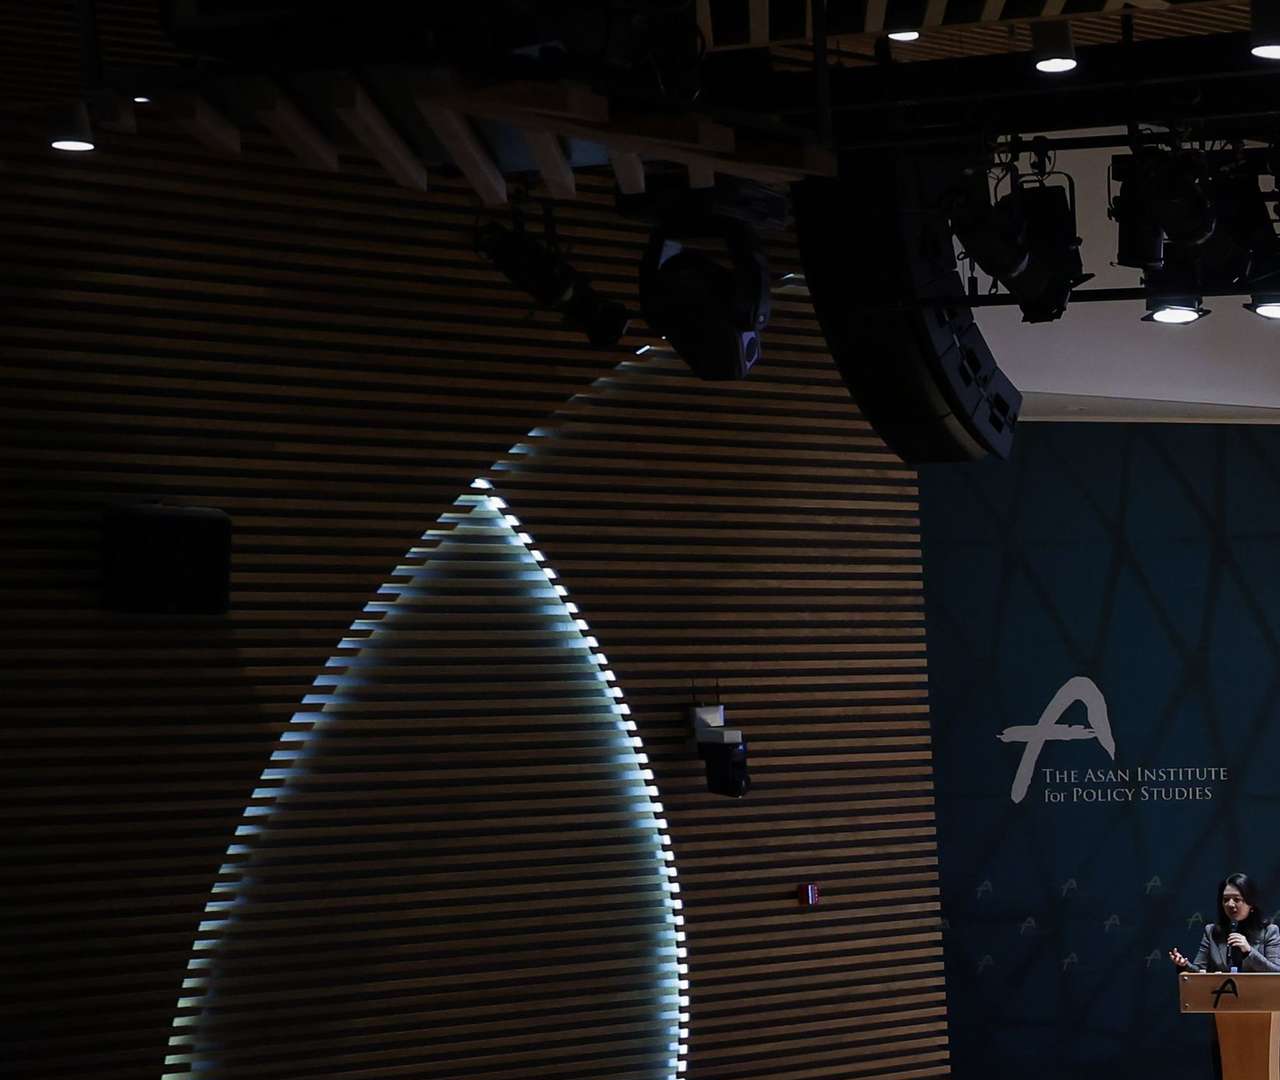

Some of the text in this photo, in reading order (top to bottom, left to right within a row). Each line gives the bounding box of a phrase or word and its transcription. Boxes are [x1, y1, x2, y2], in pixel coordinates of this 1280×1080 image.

[1042, 767, 1228, 782] THE ASAN INSTITUTE
[1045, 786, 1212, 802] for POLICY STUDIES
